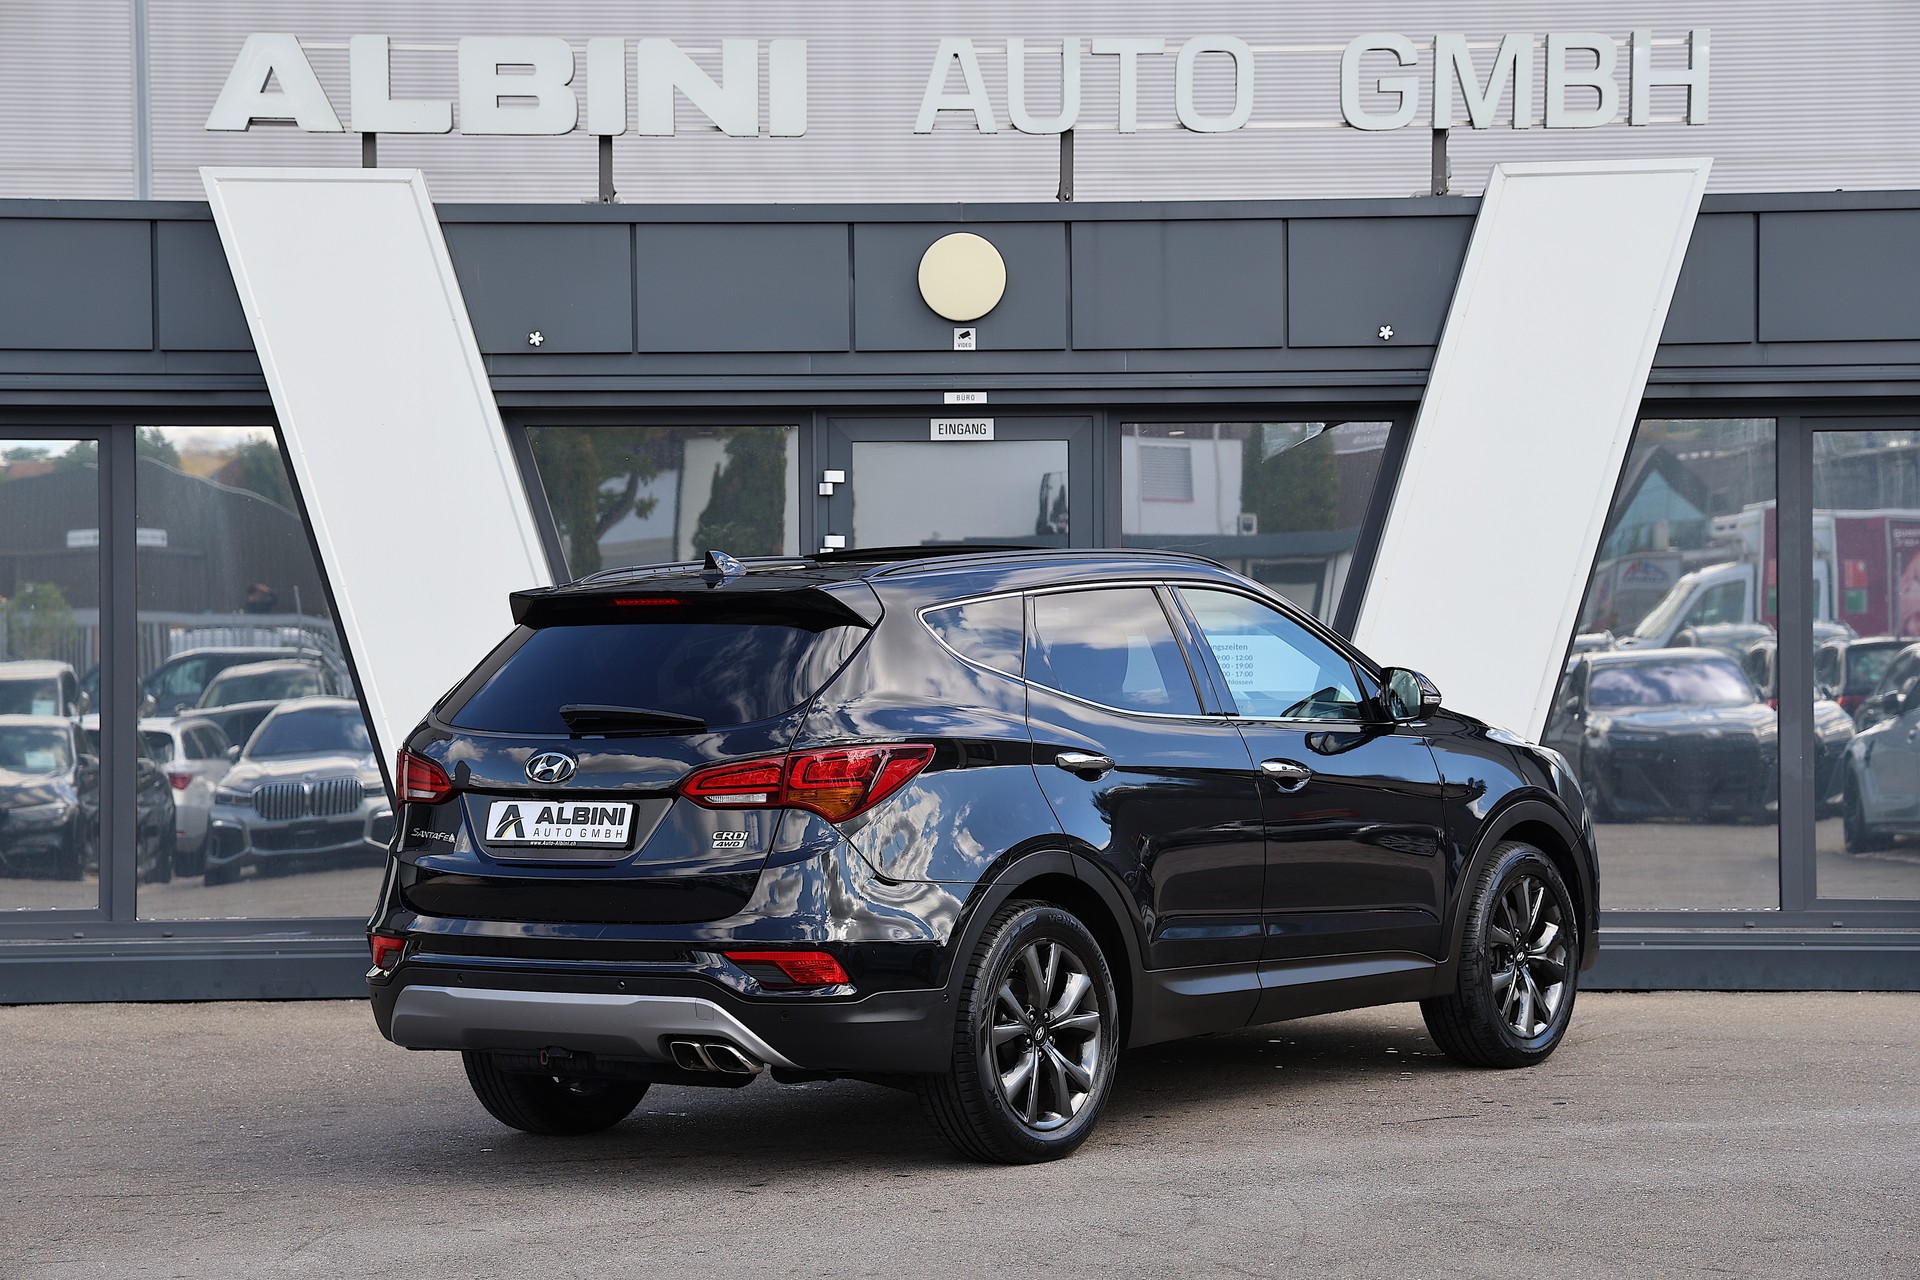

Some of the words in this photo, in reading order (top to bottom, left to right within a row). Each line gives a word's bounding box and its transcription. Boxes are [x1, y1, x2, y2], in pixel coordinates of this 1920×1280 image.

[204, 33, 808, 137] ALBINI
[913, 34, 1256, 134] AUTO
[1340, 28, 1712, 132] GMBH
[956, 393, 976, 402] BÜRO
[938, 423, 987, 435] EINGANG
[1211, 643, 1248, 651] ngszeiten
[535, 806, 627, 826] ALBINI
[533, 827, 572, 838] AUTO
[580, 828, 624, 839] GMBH
